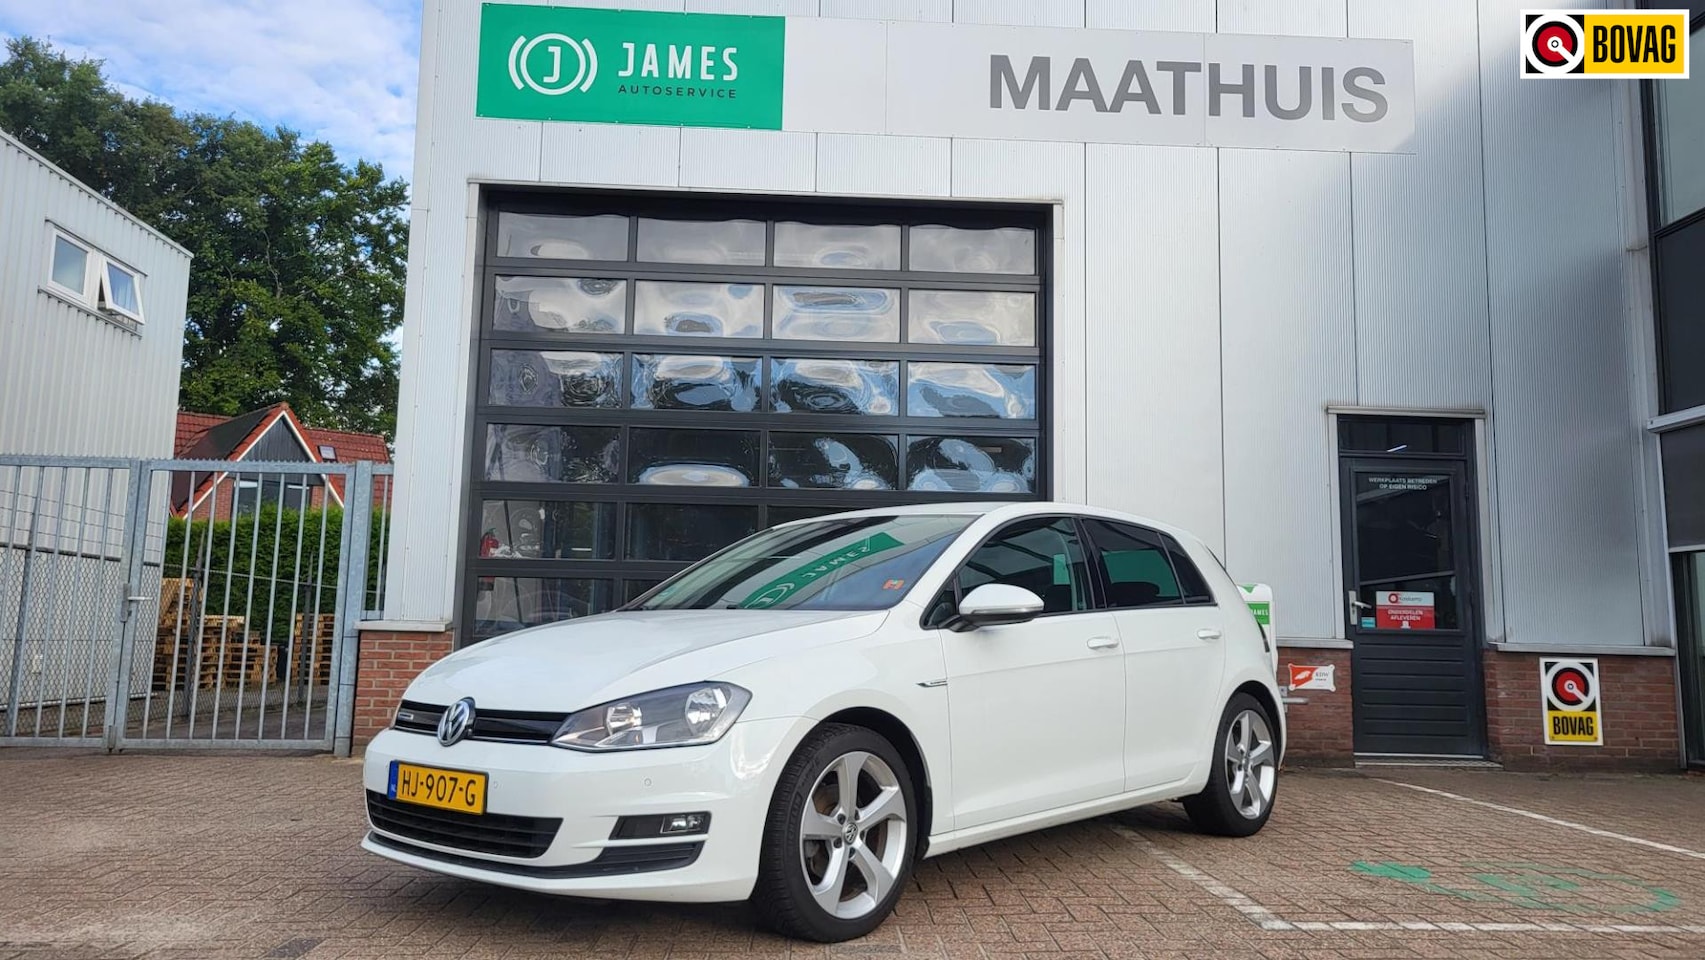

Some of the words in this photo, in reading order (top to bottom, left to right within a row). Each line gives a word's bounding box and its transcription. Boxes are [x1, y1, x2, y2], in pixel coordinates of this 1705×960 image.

[617, 42, 738, 81] JAMES
[617, 84, 737, 99] AUTOSERVICE
[989, 54, 1389, 123] MAATHUIS
[1552, 716, 1594, 736] BOVAG
[402, 770, 477, 807] HJ-907-G
